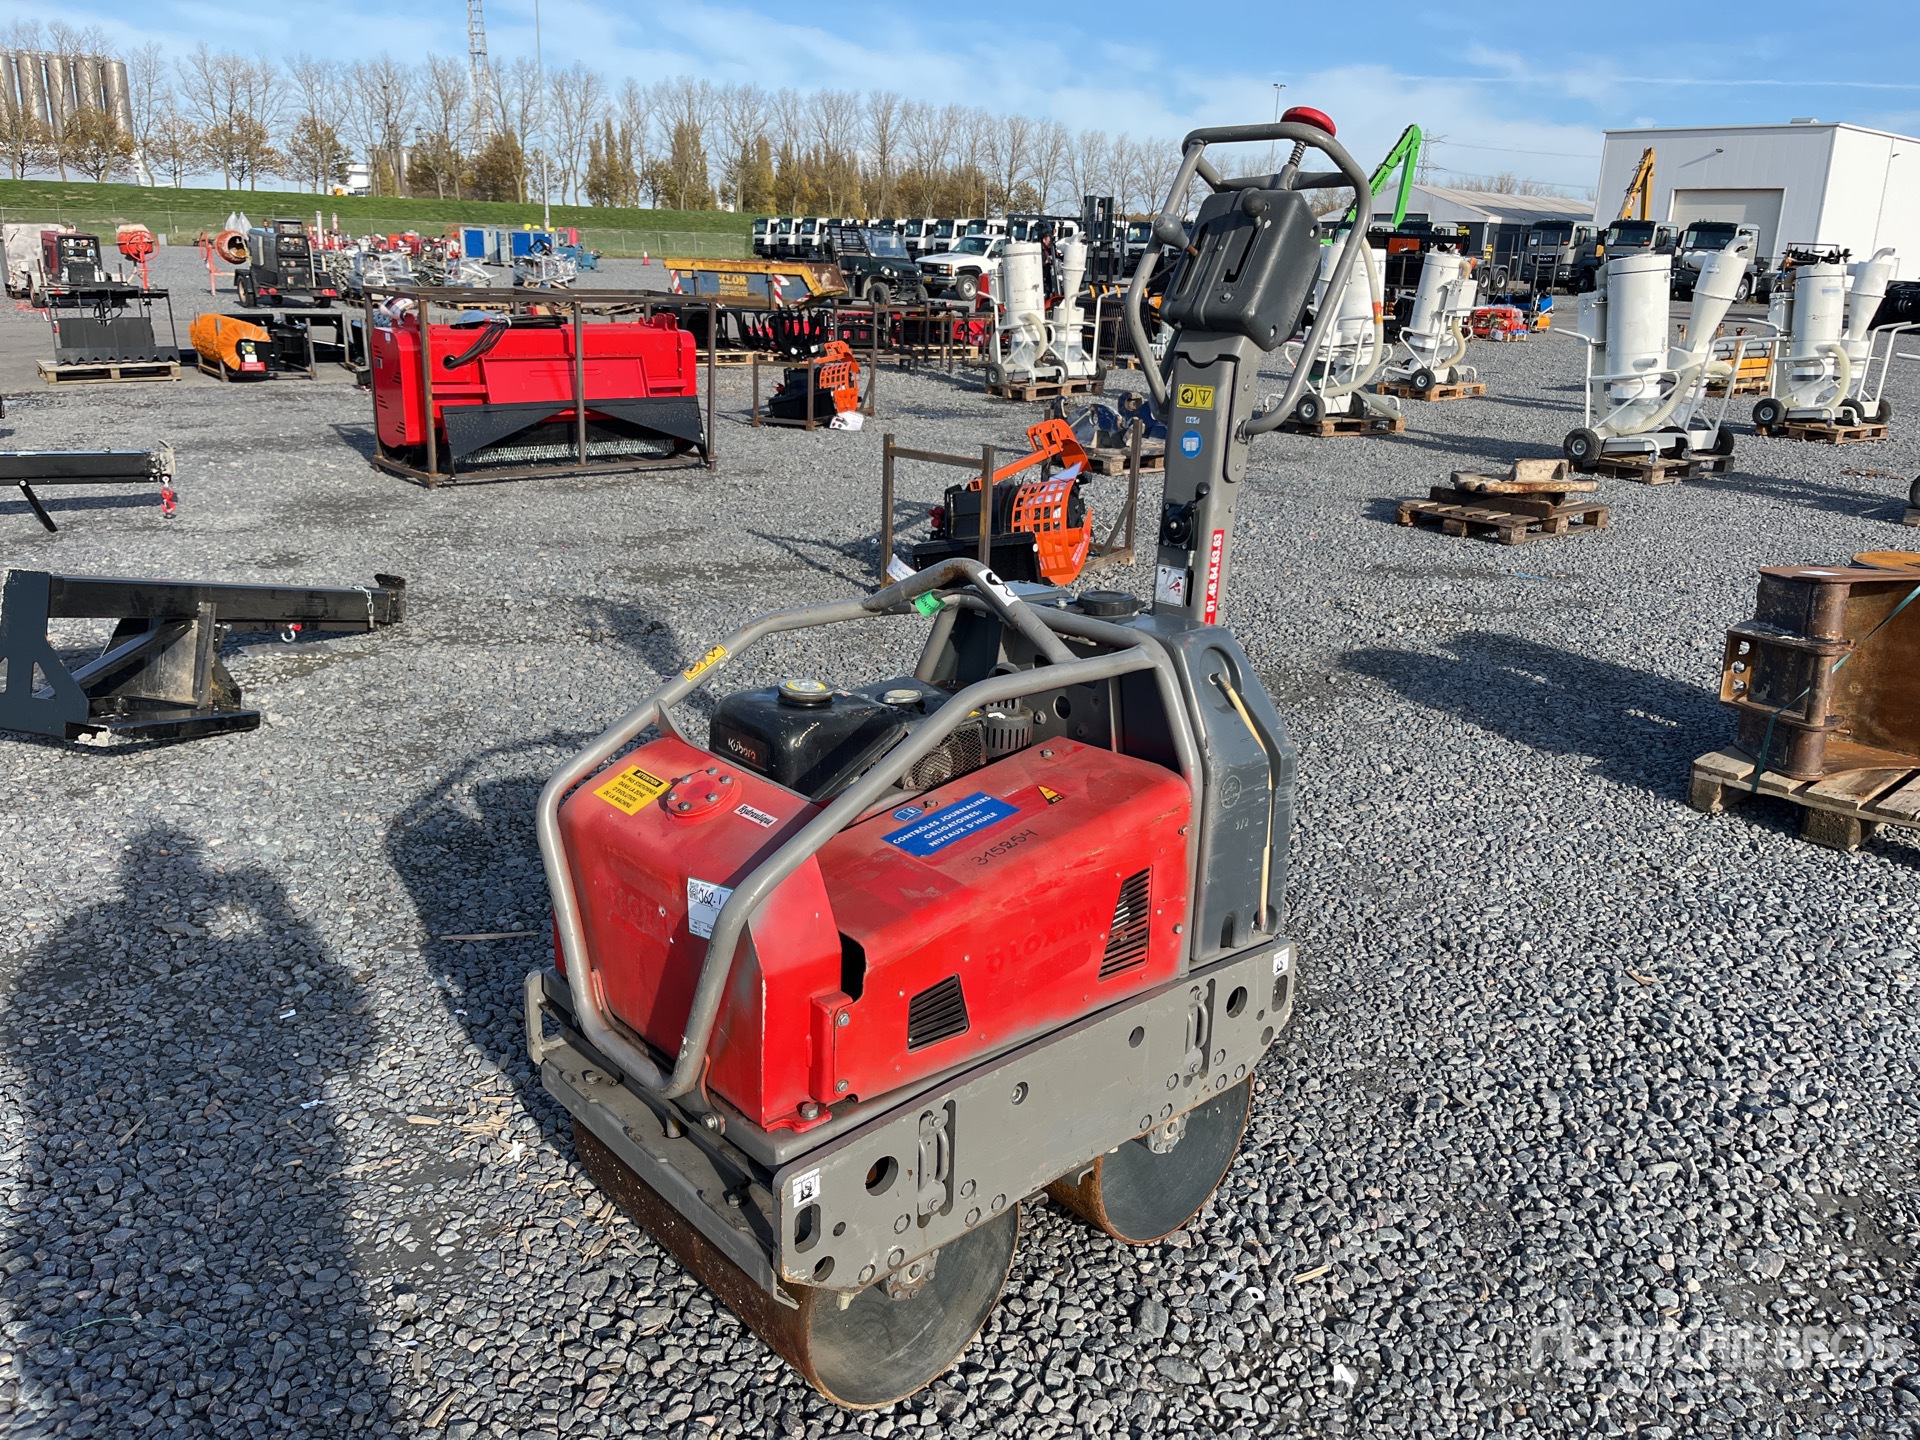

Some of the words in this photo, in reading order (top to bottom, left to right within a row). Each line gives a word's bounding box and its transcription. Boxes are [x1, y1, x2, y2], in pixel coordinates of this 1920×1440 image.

[1206, 533, 1223, 613] 01.46.64.63.63
[636, 770, 661, 787] ATTENTION
[892, 819, 941, 845] CONTRÔLES
[940, 795, 993, 823] JOURNALIERS
[923, 810, 983, 840] OBLIGATOIRES:
[928, 825, 968, 848] NIVEAUX
[966, 811, 998, 830] D'HUILE
[1008, 904, 1100, 963] LOXAM
